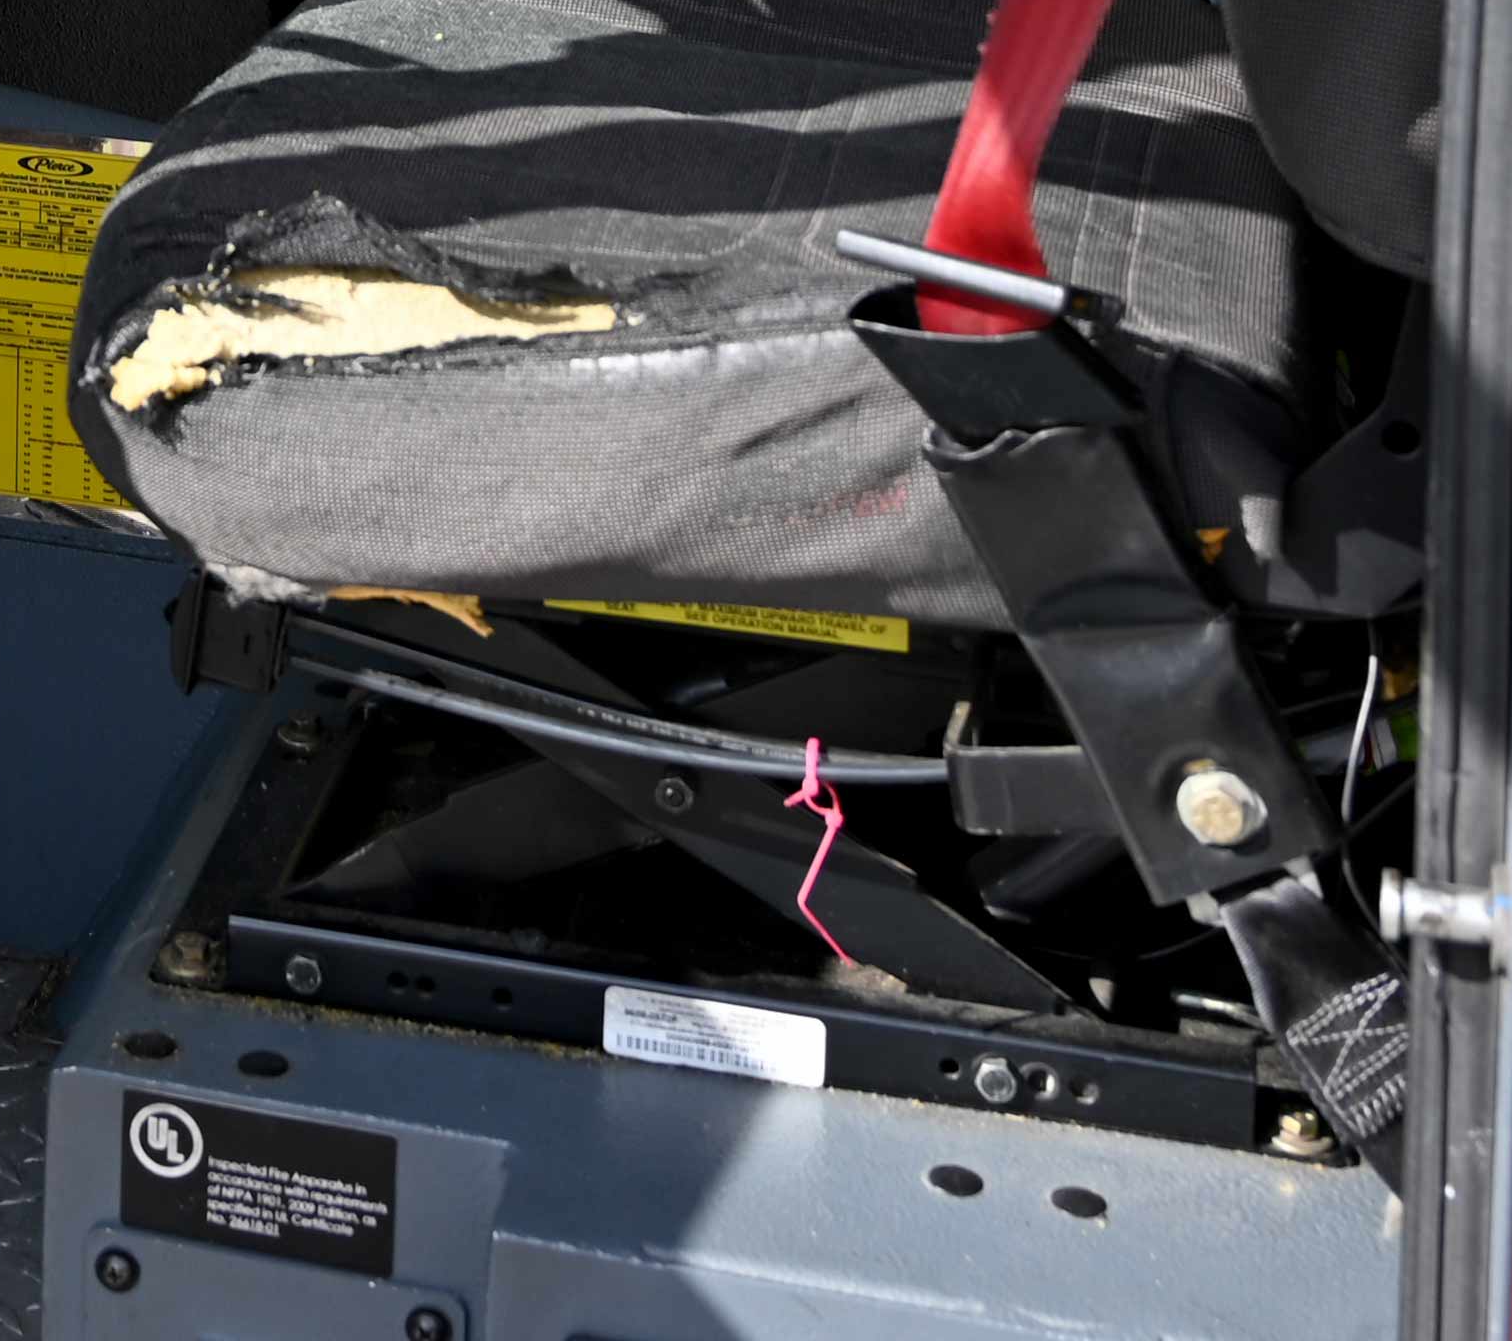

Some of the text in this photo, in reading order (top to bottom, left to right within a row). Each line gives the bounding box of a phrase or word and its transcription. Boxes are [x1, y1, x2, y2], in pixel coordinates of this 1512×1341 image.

[35, 156, 77, 173] Pierce
[685, 610, 711, 623] SEE
[713, 613, 787, 633] OPERATION
[788, 622, 840, 639] MANUAL
[819, 613, 866, 633] TRAVEL
[870, 623, 887, 635] OF
[147, 1114, 185, 1163] UL
[207, 1169, 388, 1215] accordance with requirements
[208, 1155, 367, 1196] Inspected Fire Apparatus in
[206, 1197, 354, 1237] specified in UL Certificate
[206, 1210, 226, 1226] No.
[207, 1183, 377, 1228] of NFPA 1901, 2009 Edition, as
